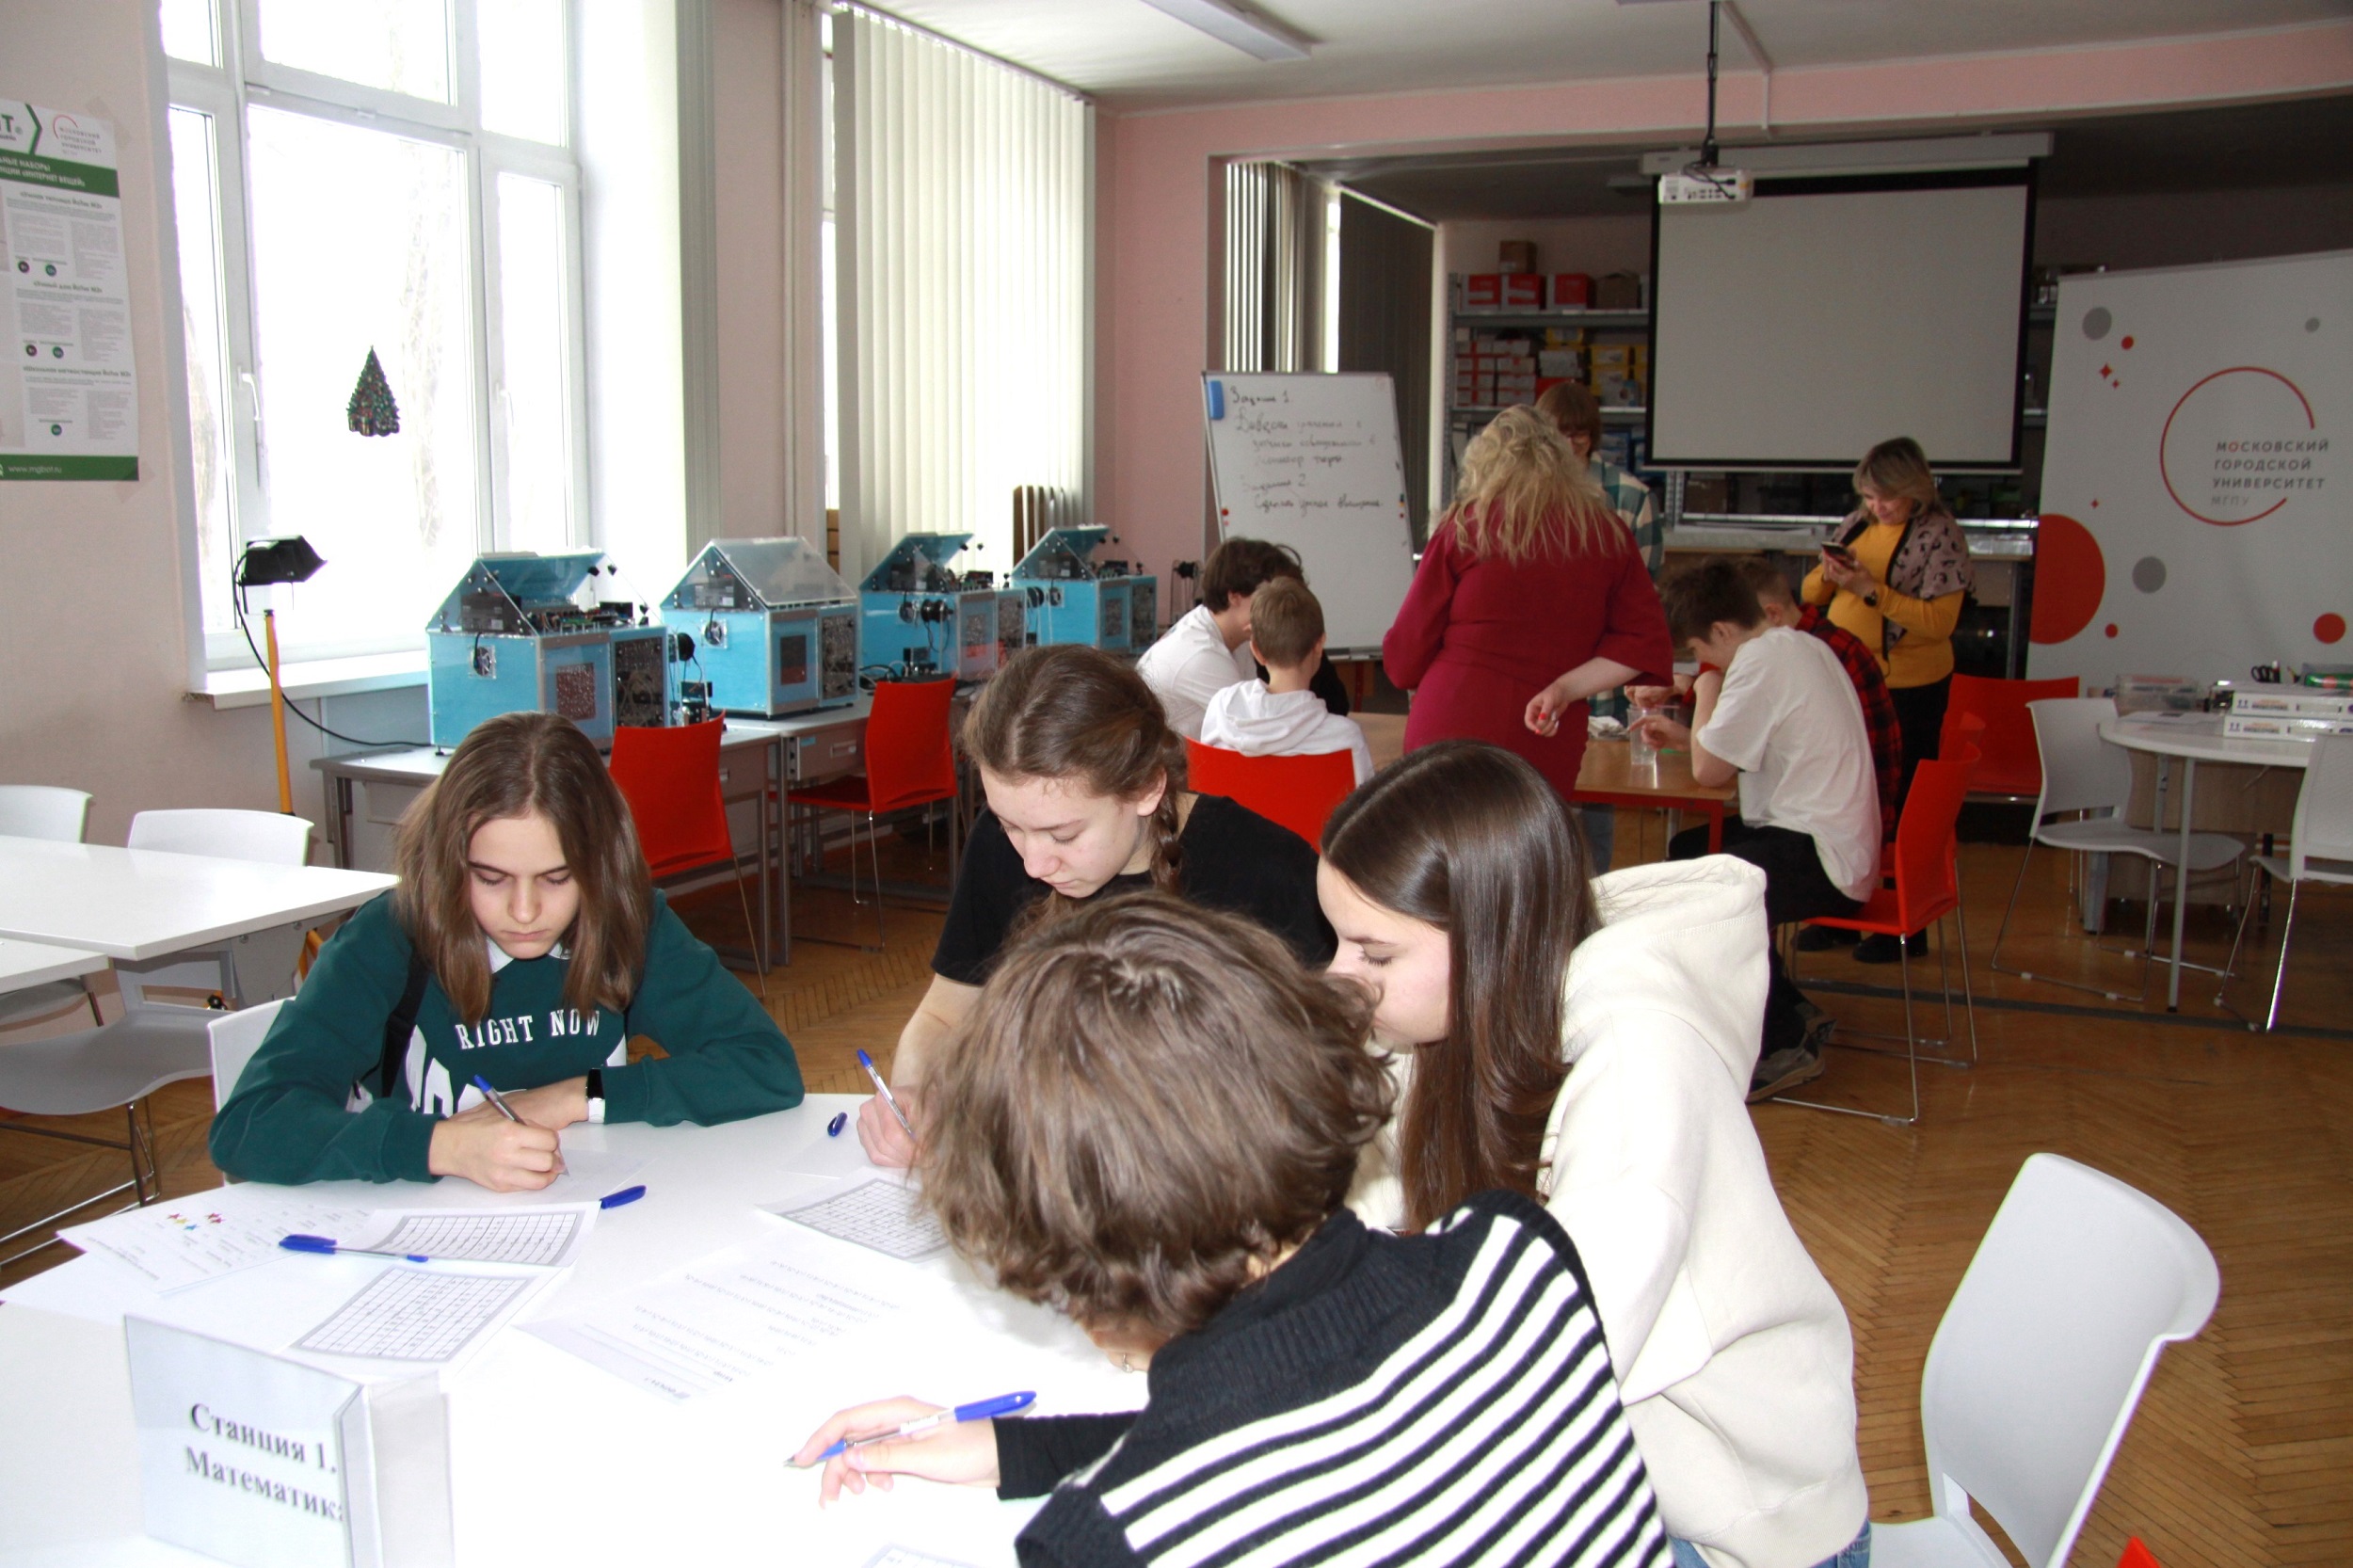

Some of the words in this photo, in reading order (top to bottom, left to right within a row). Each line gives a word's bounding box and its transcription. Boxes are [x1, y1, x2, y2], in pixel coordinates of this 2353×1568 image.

[2216, 438, 2329, 453] МОСКОВСКИЙ
[2214, 456, 2312, 472] ГОРОДСКОЙ
[1298, 472, 1306, 487] 2
[2212, 477, 2326, 489] УНИВЕРСИТЕТ
[2211, 495, 2250, 506] МГПУ
[455, 1015, 534, 1050] RIGHT
[550, 1008, 600, 1037] NOW
[190, 1402, 306, 1464] Станция
[316, 1442, 338, 1473] 1.
